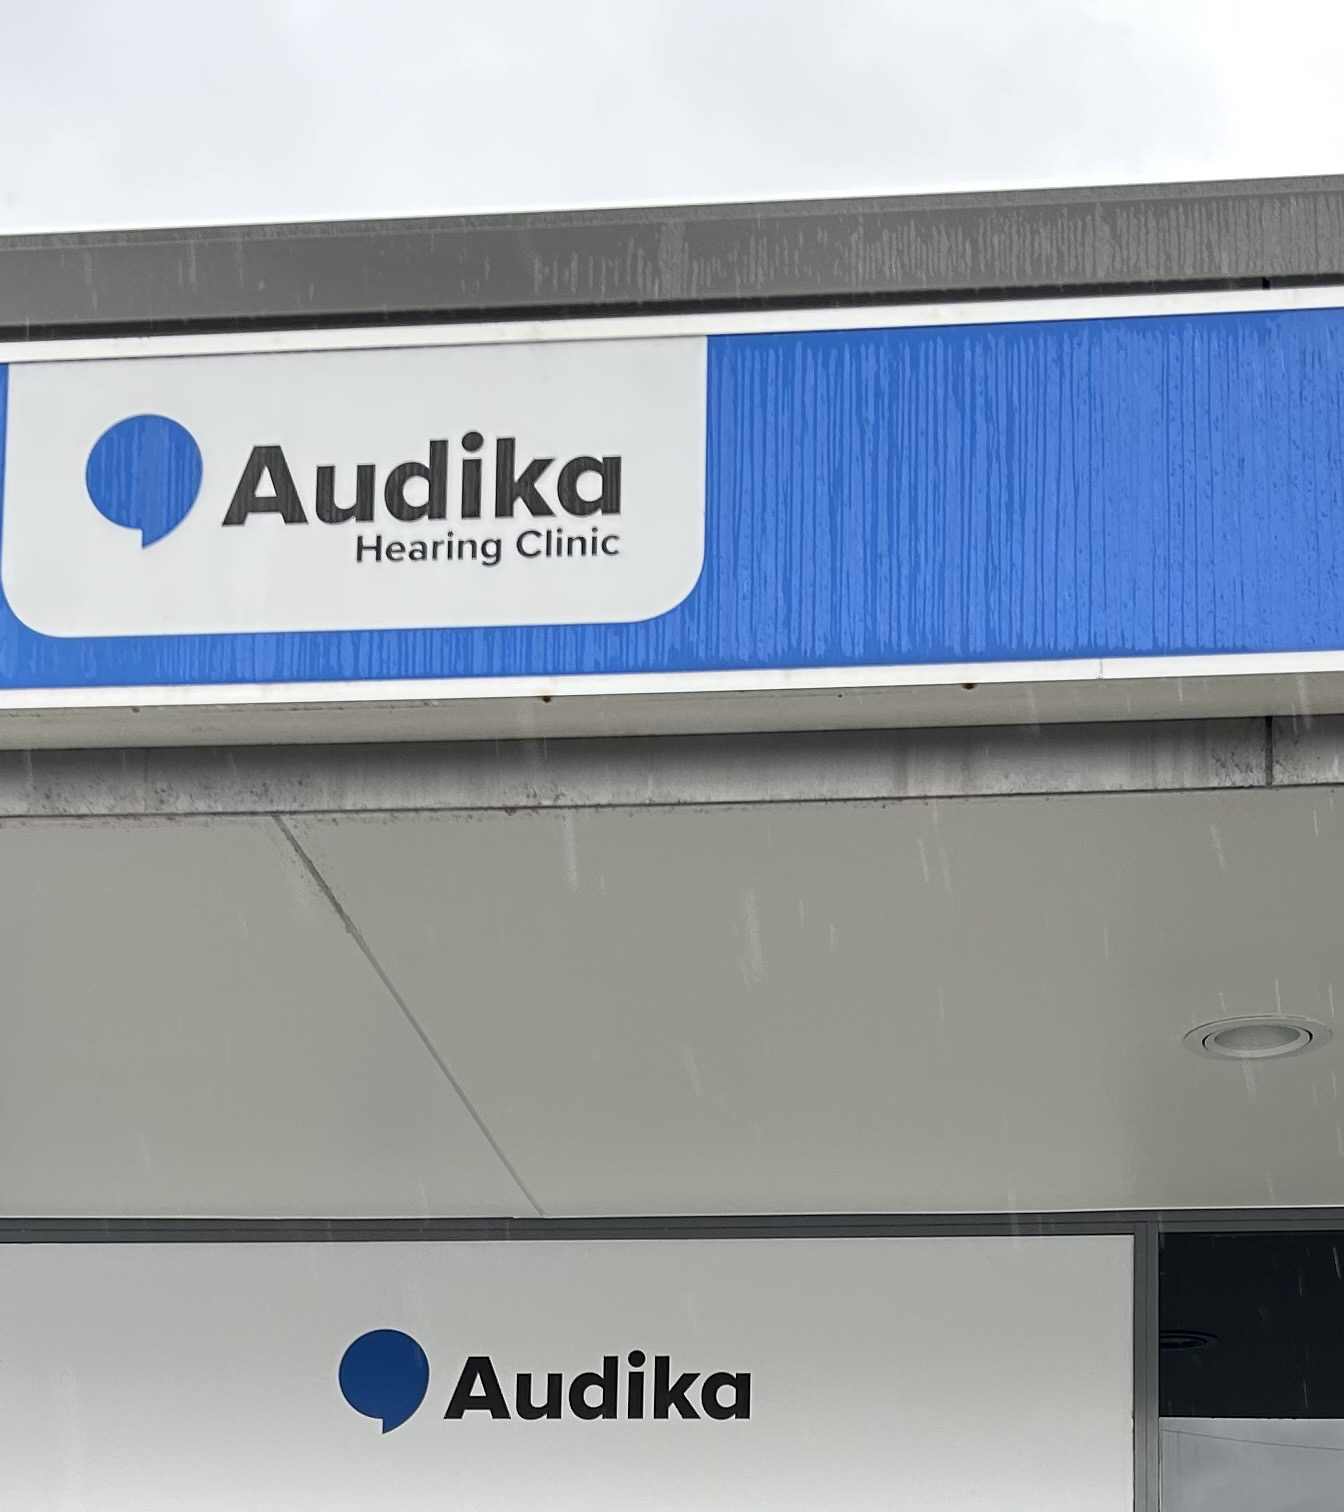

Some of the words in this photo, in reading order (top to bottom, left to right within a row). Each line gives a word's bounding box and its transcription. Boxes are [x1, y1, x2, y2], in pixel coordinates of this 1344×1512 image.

[222, 431, 622, 527] Audika
[355, 532, 502, 567] Hearing
[516, 527, 620, 559] Clinic
[443, 1350, 752, 1420] Audika
